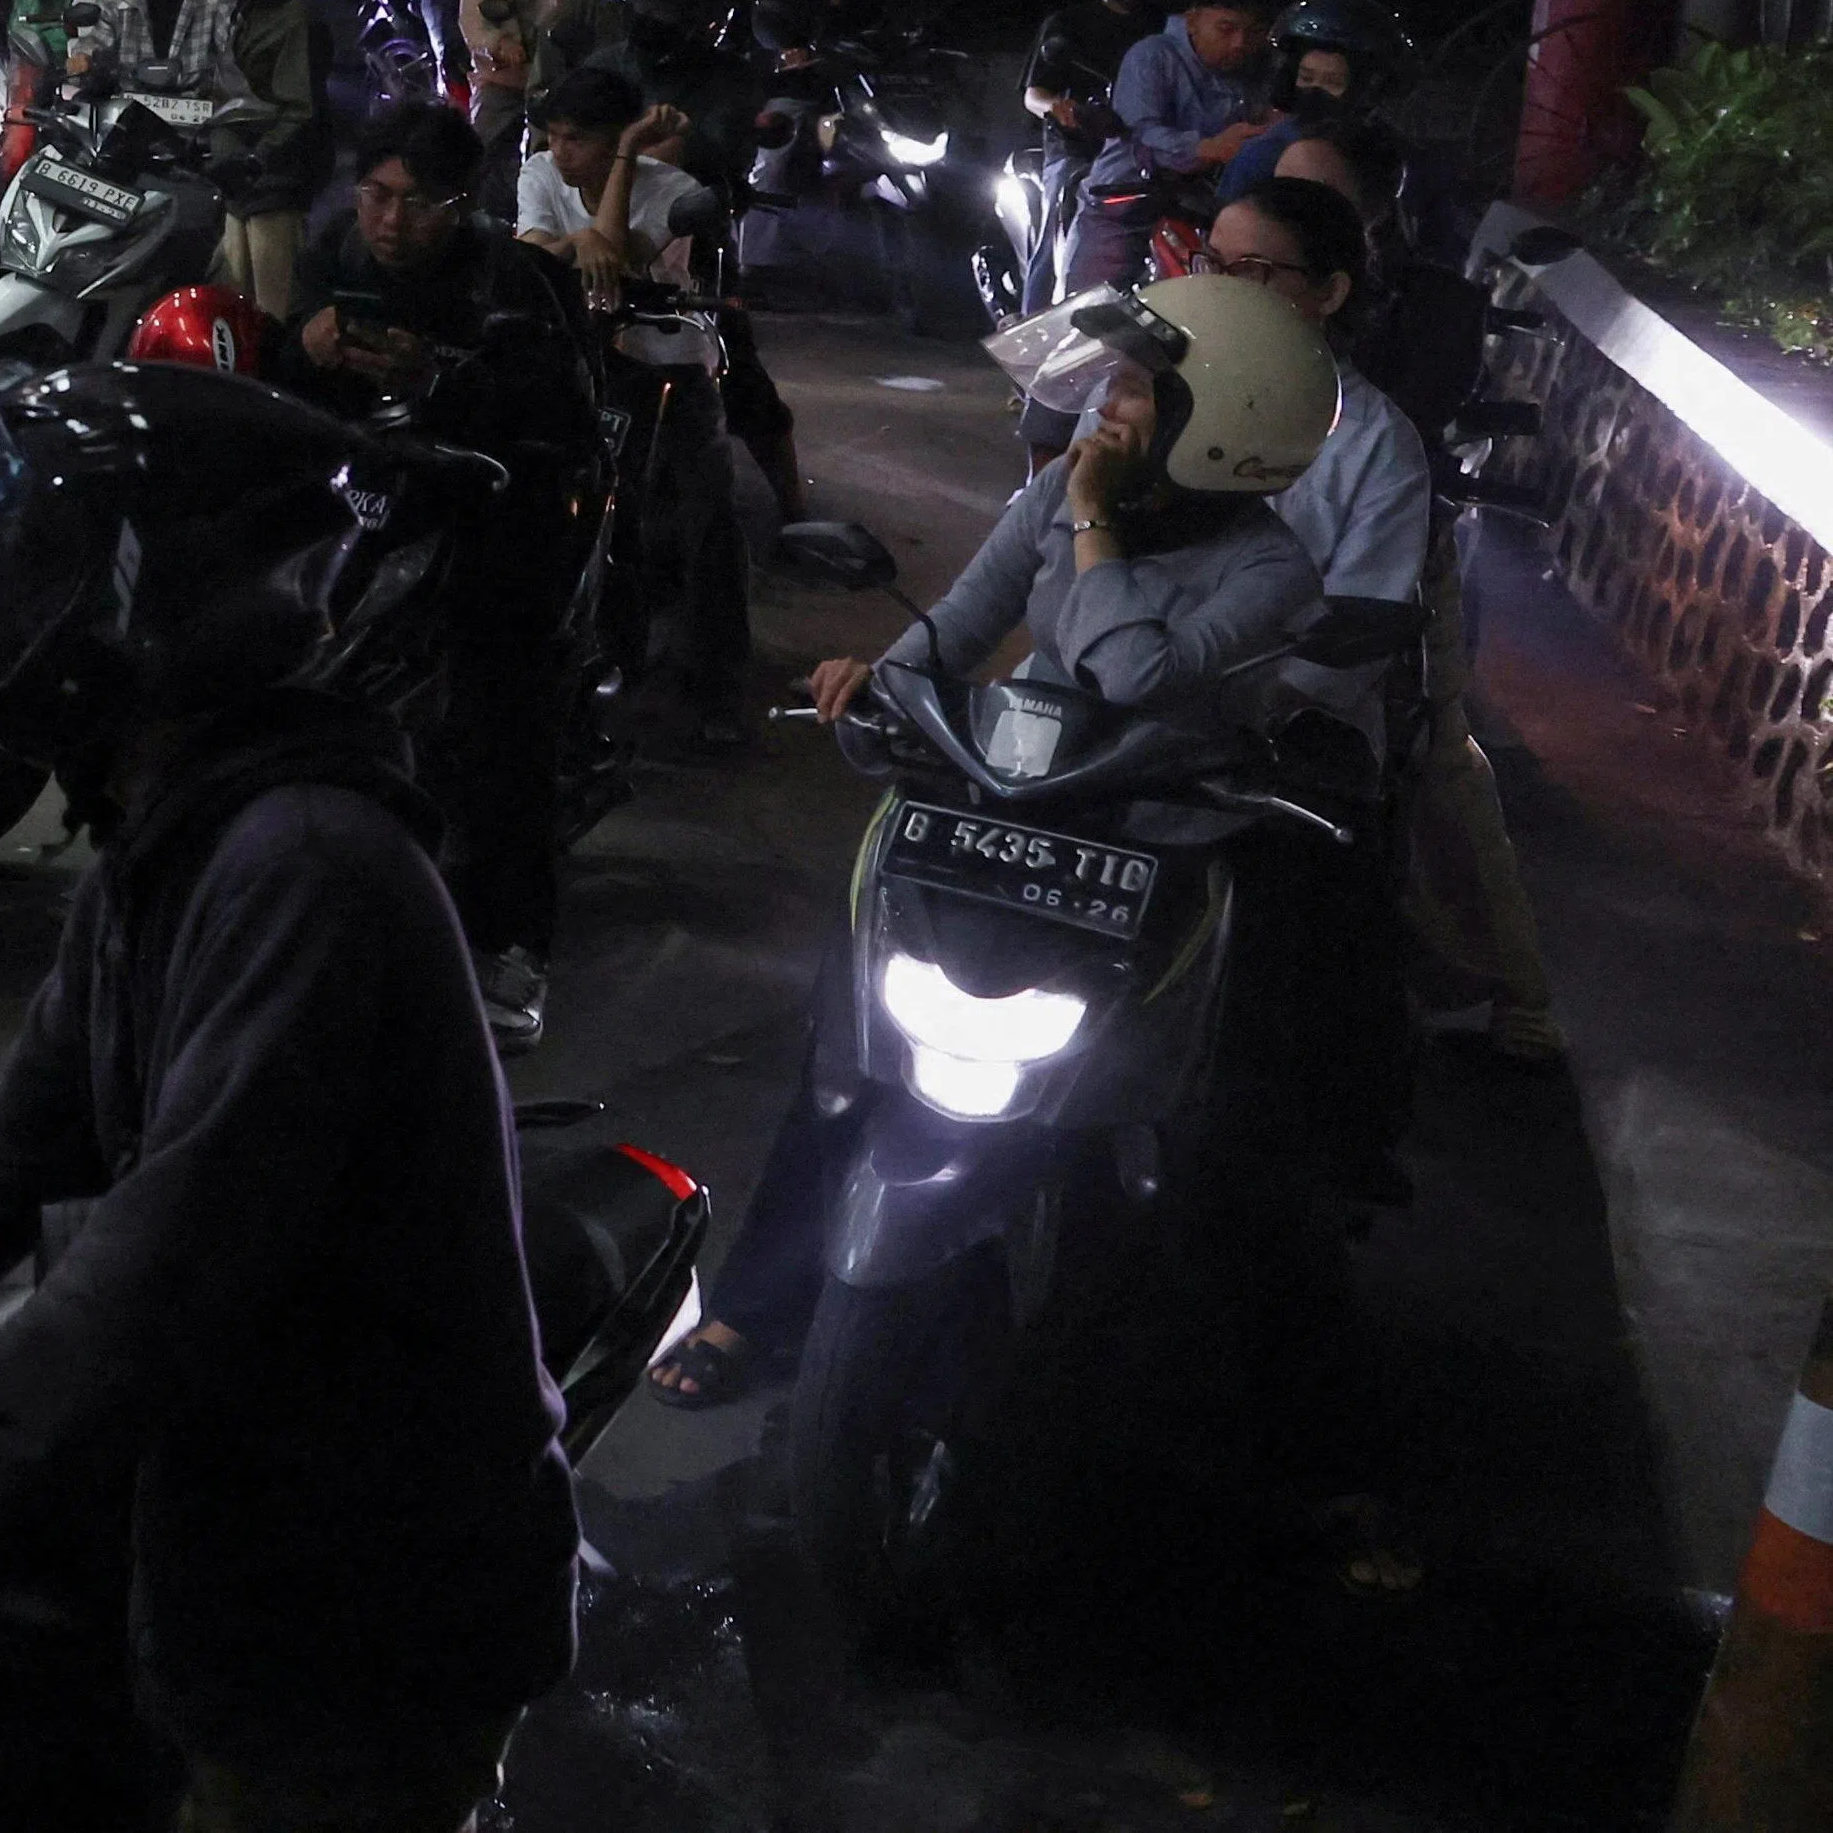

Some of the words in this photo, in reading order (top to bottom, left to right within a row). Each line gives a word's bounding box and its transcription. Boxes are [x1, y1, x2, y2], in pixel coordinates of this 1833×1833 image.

[39, 163, 51, 175] B
[57, 168, 97, 193] 6619
[950, 820, 1057, 869] 5435
